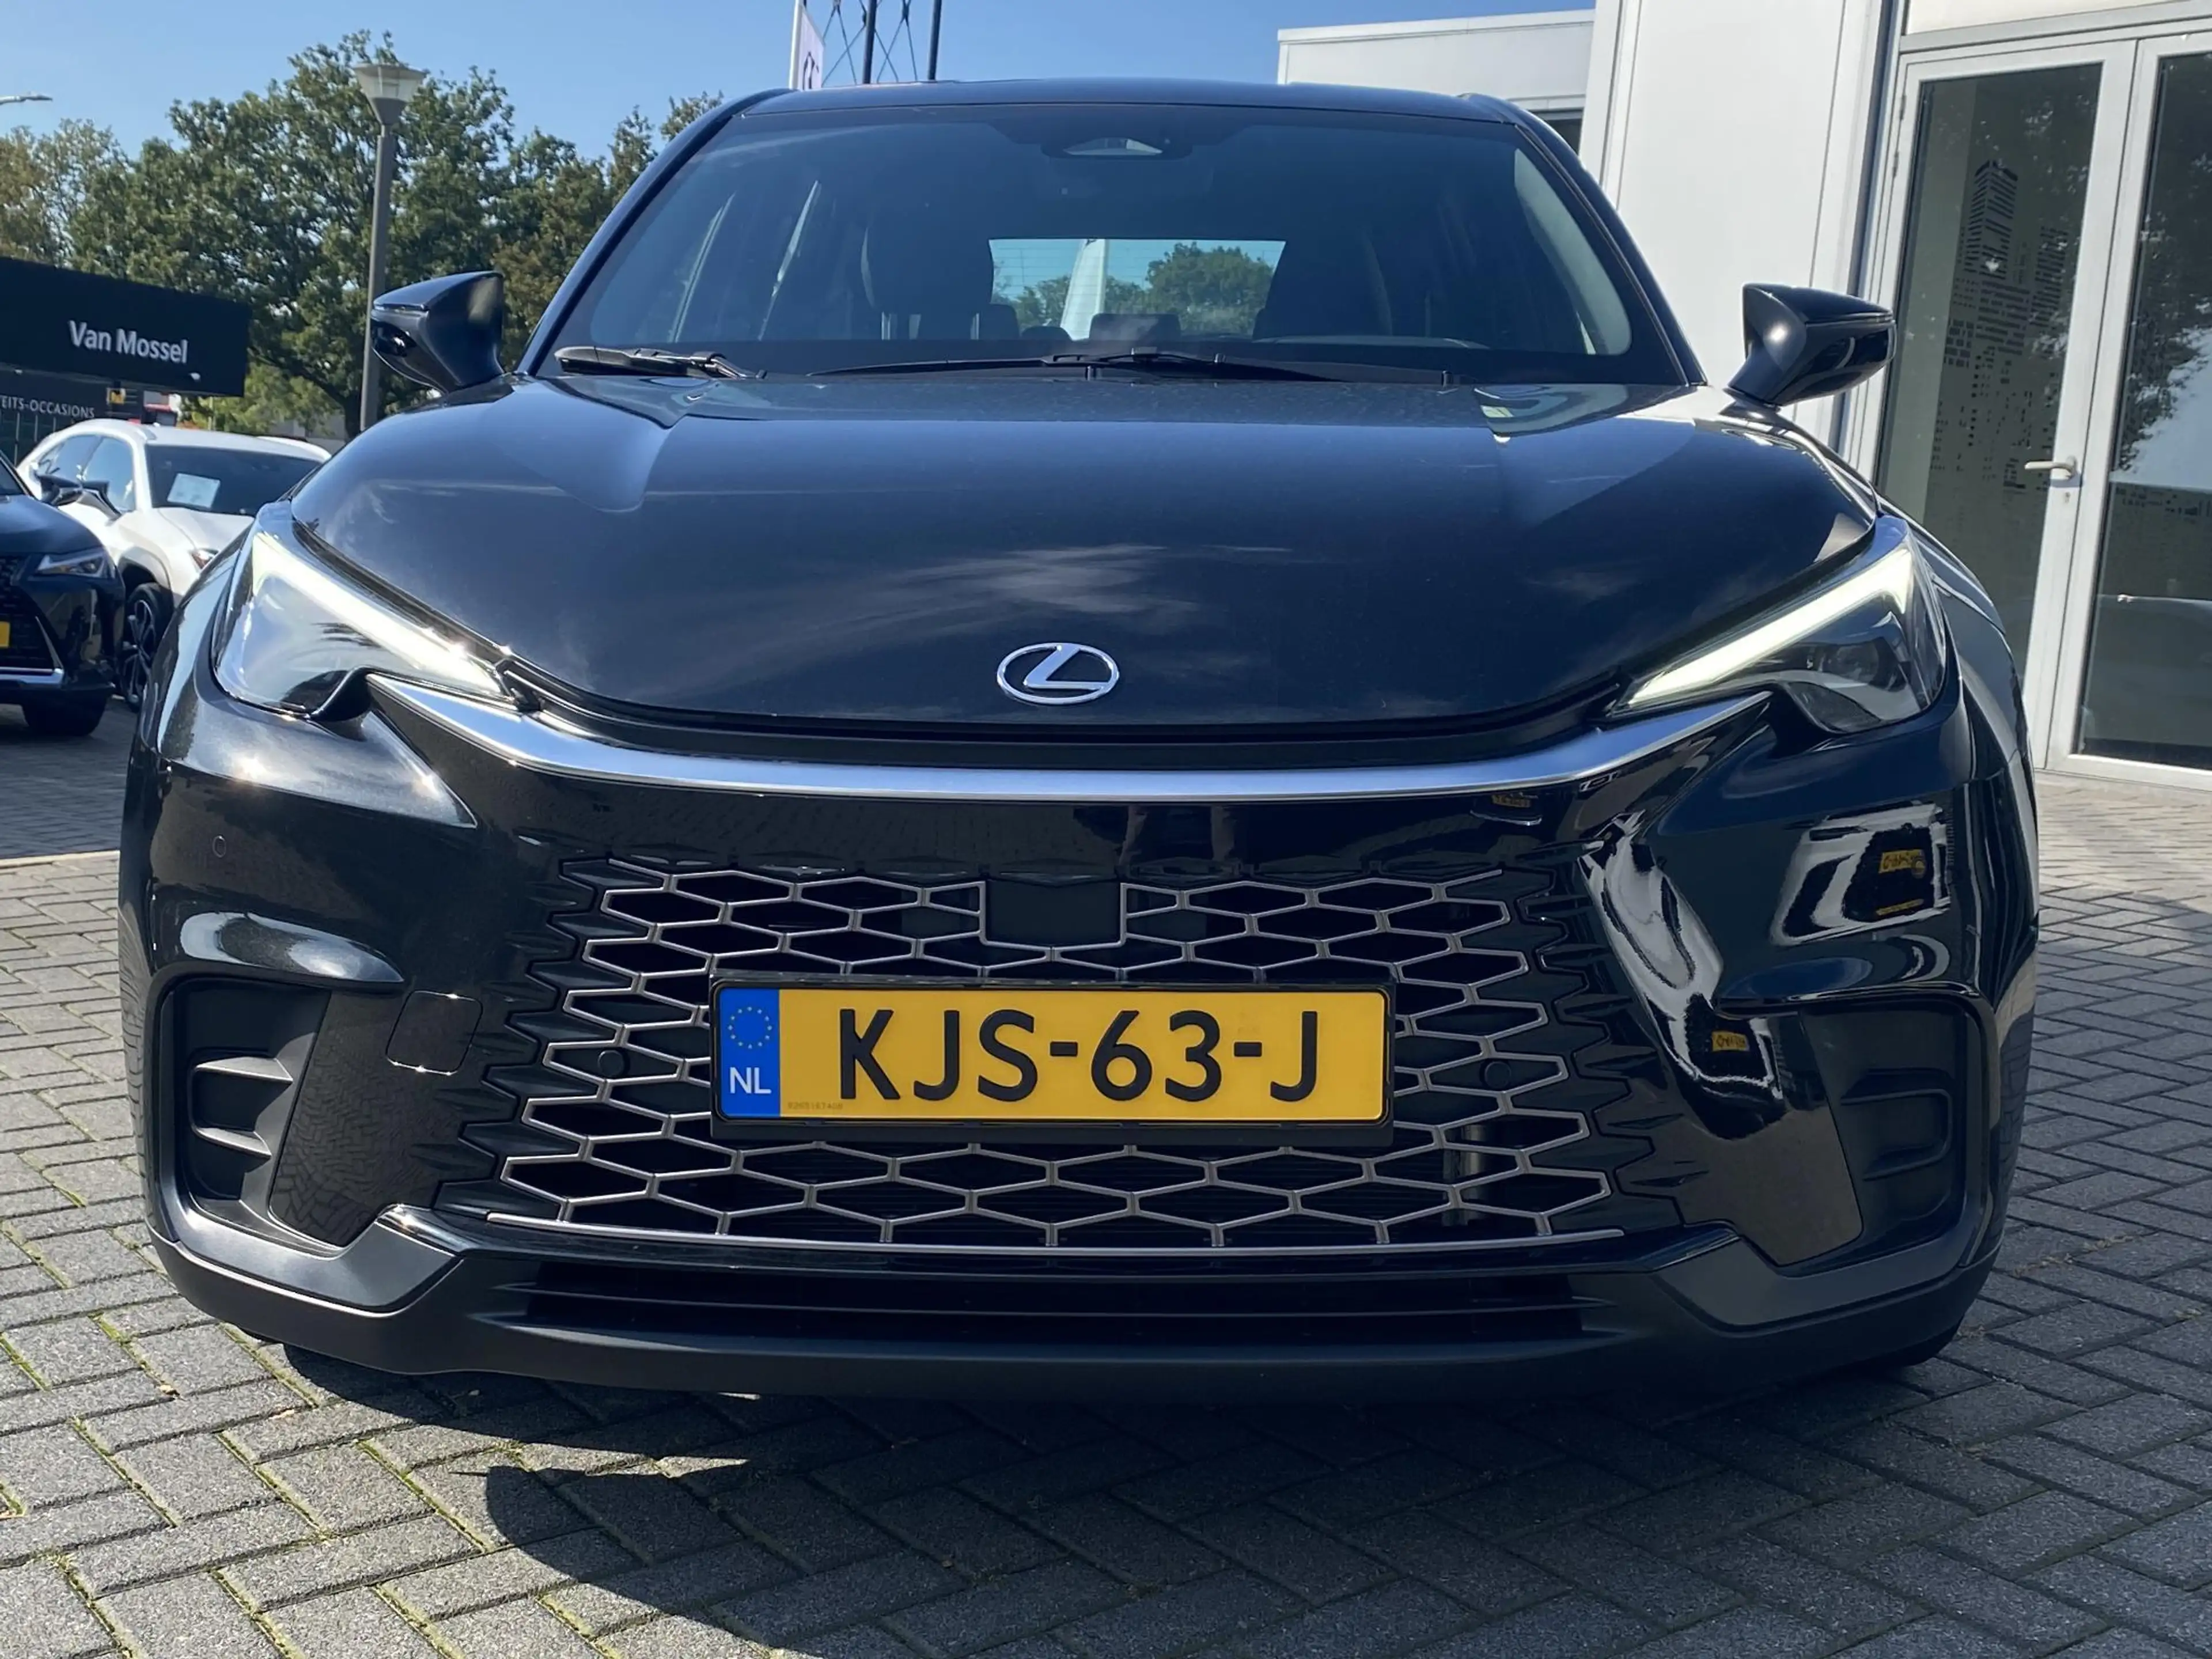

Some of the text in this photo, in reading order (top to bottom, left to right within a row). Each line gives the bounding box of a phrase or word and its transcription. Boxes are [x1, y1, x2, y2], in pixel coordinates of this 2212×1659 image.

[69, 320, 188, 364] Van Mossel
[839, 1008, 1318, 1103] KJS-63-J
[729, 1066, 771, 1094] NL
